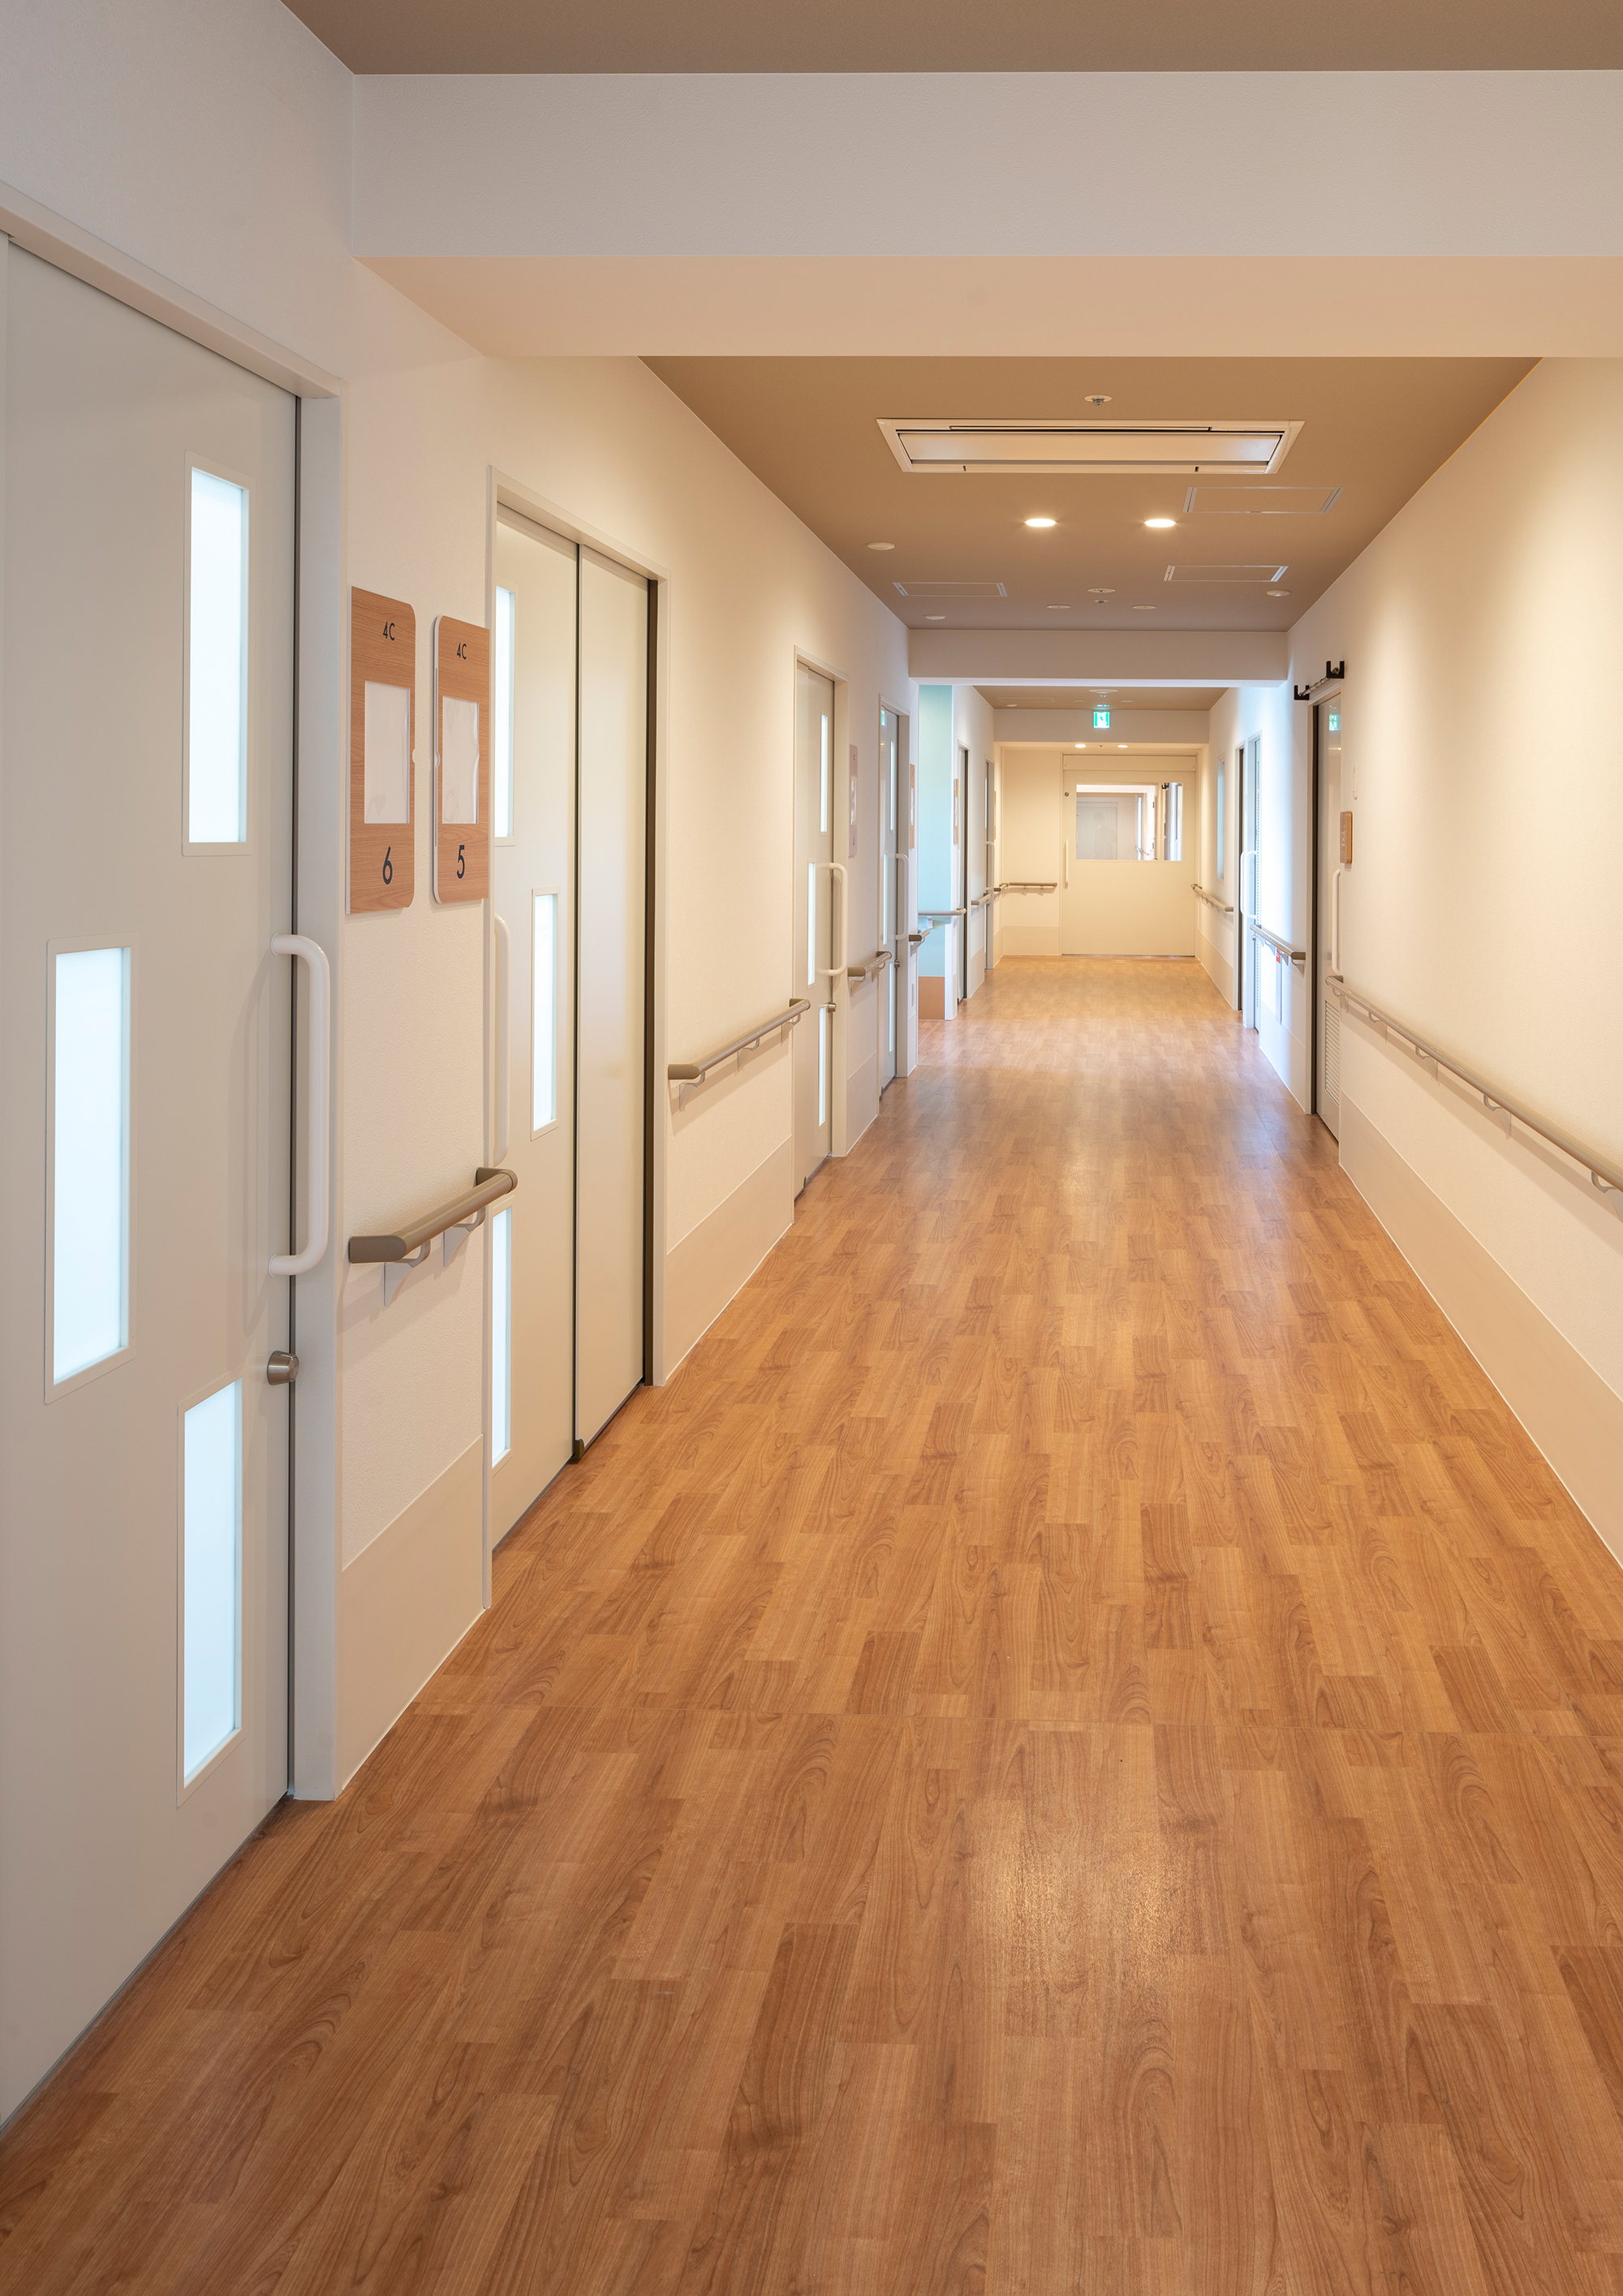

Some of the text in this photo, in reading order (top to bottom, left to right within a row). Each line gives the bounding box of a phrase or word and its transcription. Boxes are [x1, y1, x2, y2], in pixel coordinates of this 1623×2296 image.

[382, 621, 395, 641] 4C
[456, 642, 467, 660] 4C
[382, 846, 393, 885] 6
[456, 844, 465, 879] 5
